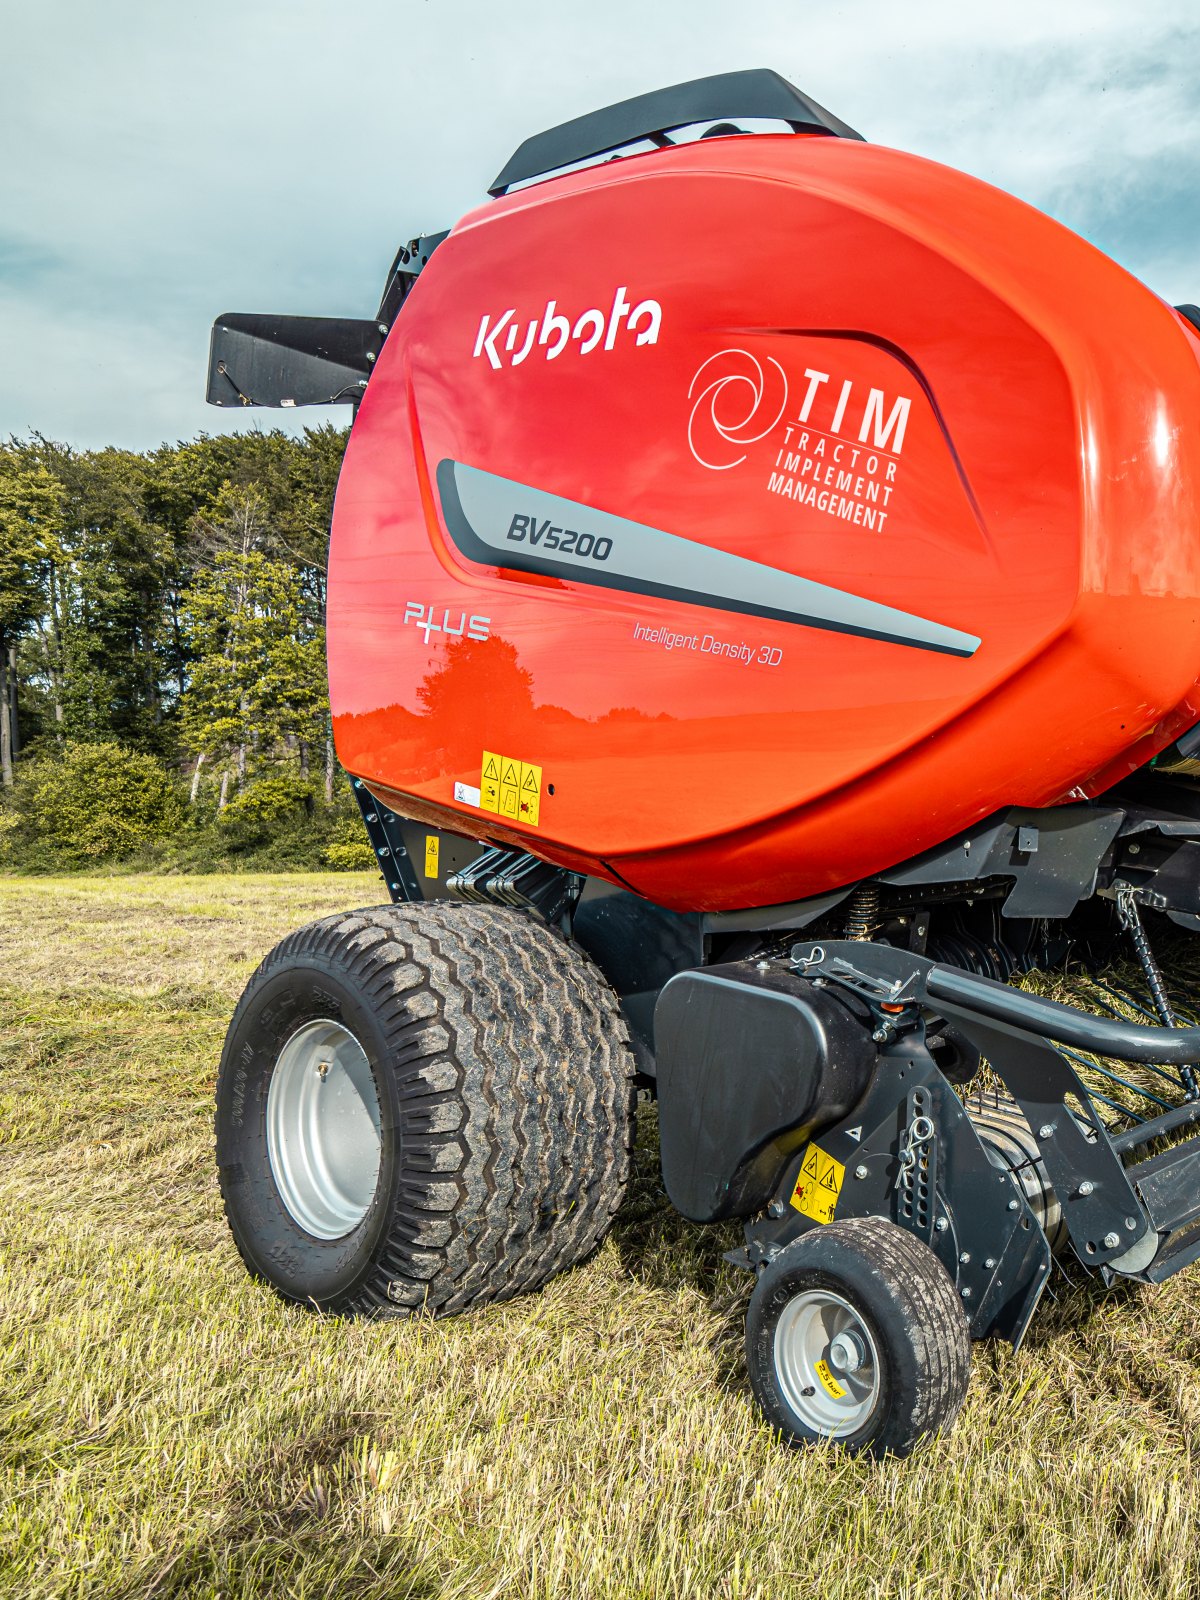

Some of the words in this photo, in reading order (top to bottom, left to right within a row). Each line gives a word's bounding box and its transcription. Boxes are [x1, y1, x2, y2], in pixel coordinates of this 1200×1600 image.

[473, 286, 662, 370] Kubota
[797, 368, 912, 453] TIM
[775, 448, 894, 505] IMPLEMENT
[783, 425, 898, 482] TRACTOR
[767, 471, 889, 533] MANAGEMENT
[507, 513, 614, 561] BV5200
[633, 622, 698, 650] Intelligent
[700, 627, 757, 666] Density
[759, 646, 783, 667] 3D
[819, 1364, 831, 1381] 2,5
[827, 1381, 841, 1396] bar
